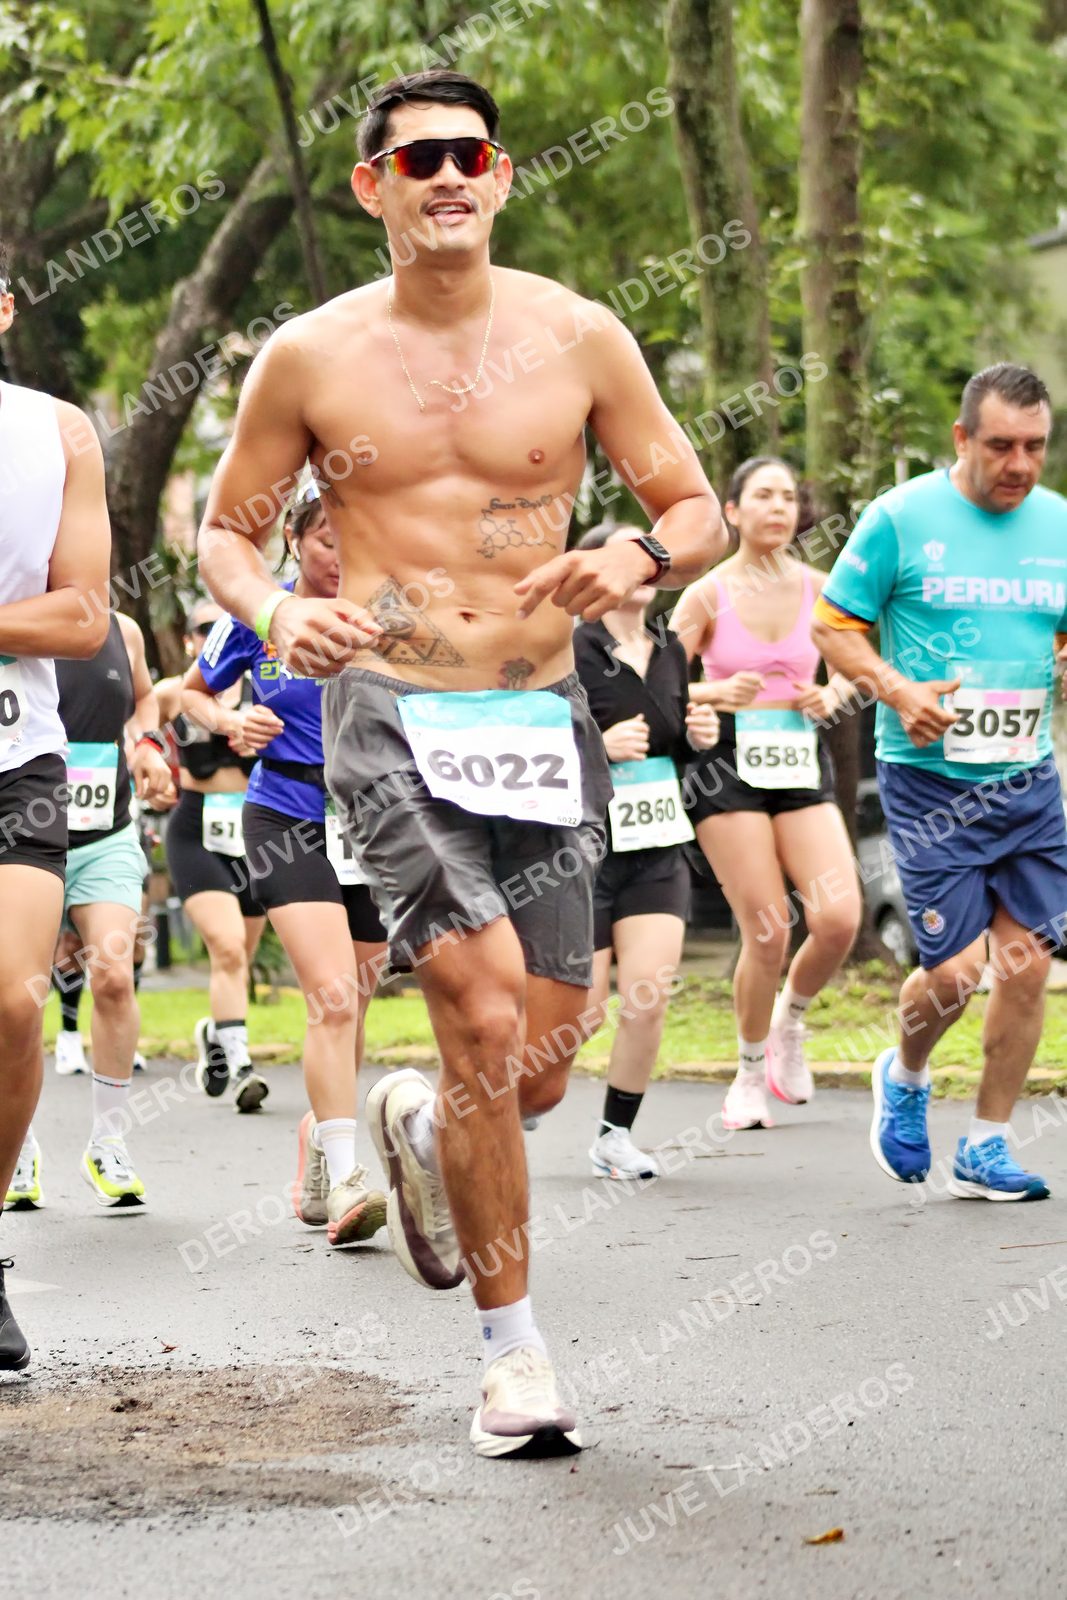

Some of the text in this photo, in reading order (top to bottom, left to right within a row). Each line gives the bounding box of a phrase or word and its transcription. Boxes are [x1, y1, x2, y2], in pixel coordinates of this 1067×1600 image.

[951, 708, 1040, 738] 3057
[427, 750, 568, 790] 6022
[745, 746, 810, 768] 6582
[617, 797, 676, 828] 2860
